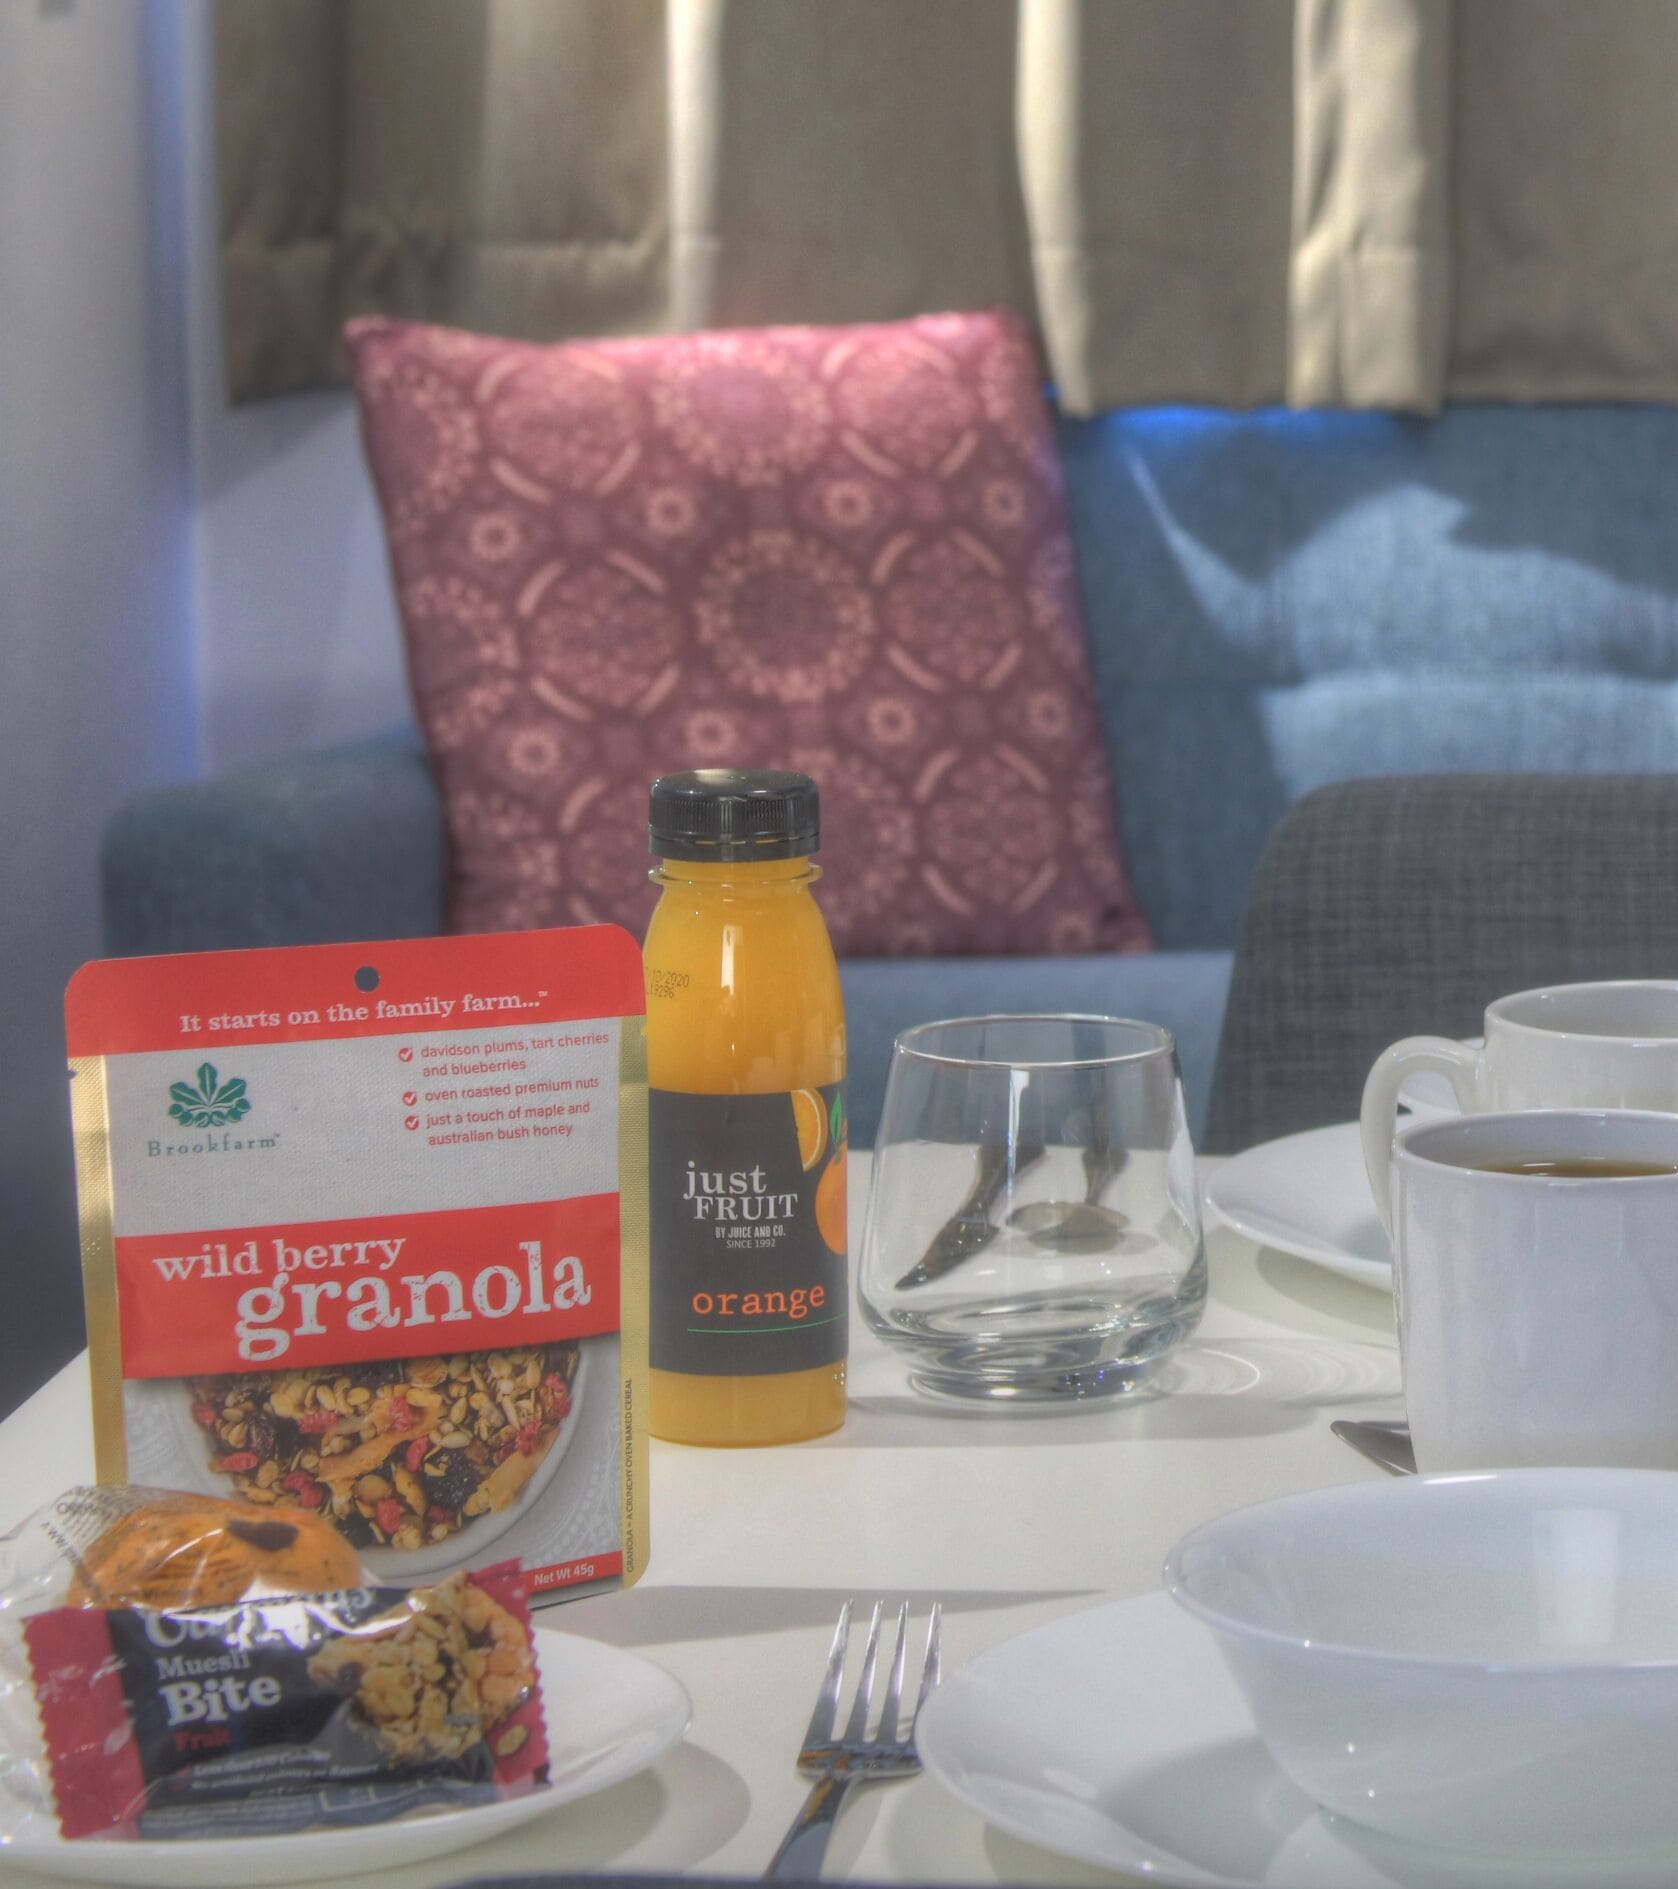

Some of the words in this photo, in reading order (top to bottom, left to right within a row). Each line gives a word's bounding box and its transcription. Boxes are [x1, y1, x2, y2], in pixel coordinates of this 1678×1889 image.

[179, 1014, 201, 1033] It
[208, 1010, 281, 1031] starts
[287, 1009, 320, 1026] on
[326, 1004, 369, 1022] the
[375, 996, 456, 1022] family
[420, 1044, 480, 1058] davidson
[484, 1039, 529, 1057] plums,
[531, 1036, 554, 1050] tart
[557, 1032, 609, 1048] cherries
[423, 1064, 448, 1077] and
[451, 1058, 527, 1075] blueberries
[425, 1089, 458, 1102] oven
[461, 1083, 511, 1099] roasted
[515, 1078, 572, 1096] premium
[575, 1076, 600, 1089] nuts
[426, 1113, 453, 1129] just
[455, 1113, 463, 1124] a
[467, 1108, 505, 1122] touch
[508, 1105, 522, 1120] of
[525, 1103, 566, 1121] maple
[568, 1101, 590, 1115] and
[428, 1129, 494, 1146] australian
[497, 1125, 530, 1140] bush
[533, 1123, 574, 1138] honey
[682, 1160, 767, 1200] just
[692, 1192, 798, 1221] FRUIT
[715, 1226, 726, 1239] BY
[728, 1225, 752, 1239] JUICE
[754, 1225, 771, 1238] AND
[772, 1224, 786, 1237] CO.
[726, 1239, 752, 1249] SINCE
[755, 1238, 776, 1248] 1992
[152, 1241, 262, 1283] wild
[272, 1235, 406, 1275] berry
[233, 1240, 591, 1362] granola
[692, 1285, 826, 1320] orange
[624, 1378, 632, 1411] CEREAL
[625, 1413, 633, 1441] BAKED
[625, 1442, 633, 1468] OVEN
[625, 1470, 633, 1512] CRUNCHY
[626, 1529, 635, 1573] GRANOLA
[533, 1572, 554, 1586] Net
[556, 1567, 571, 1579] Wt
[573, 1563, 595, 1578] 45g
[155, 1648, 251, 1680] Muesli
[157, 1675, 282, 1727] Bite
